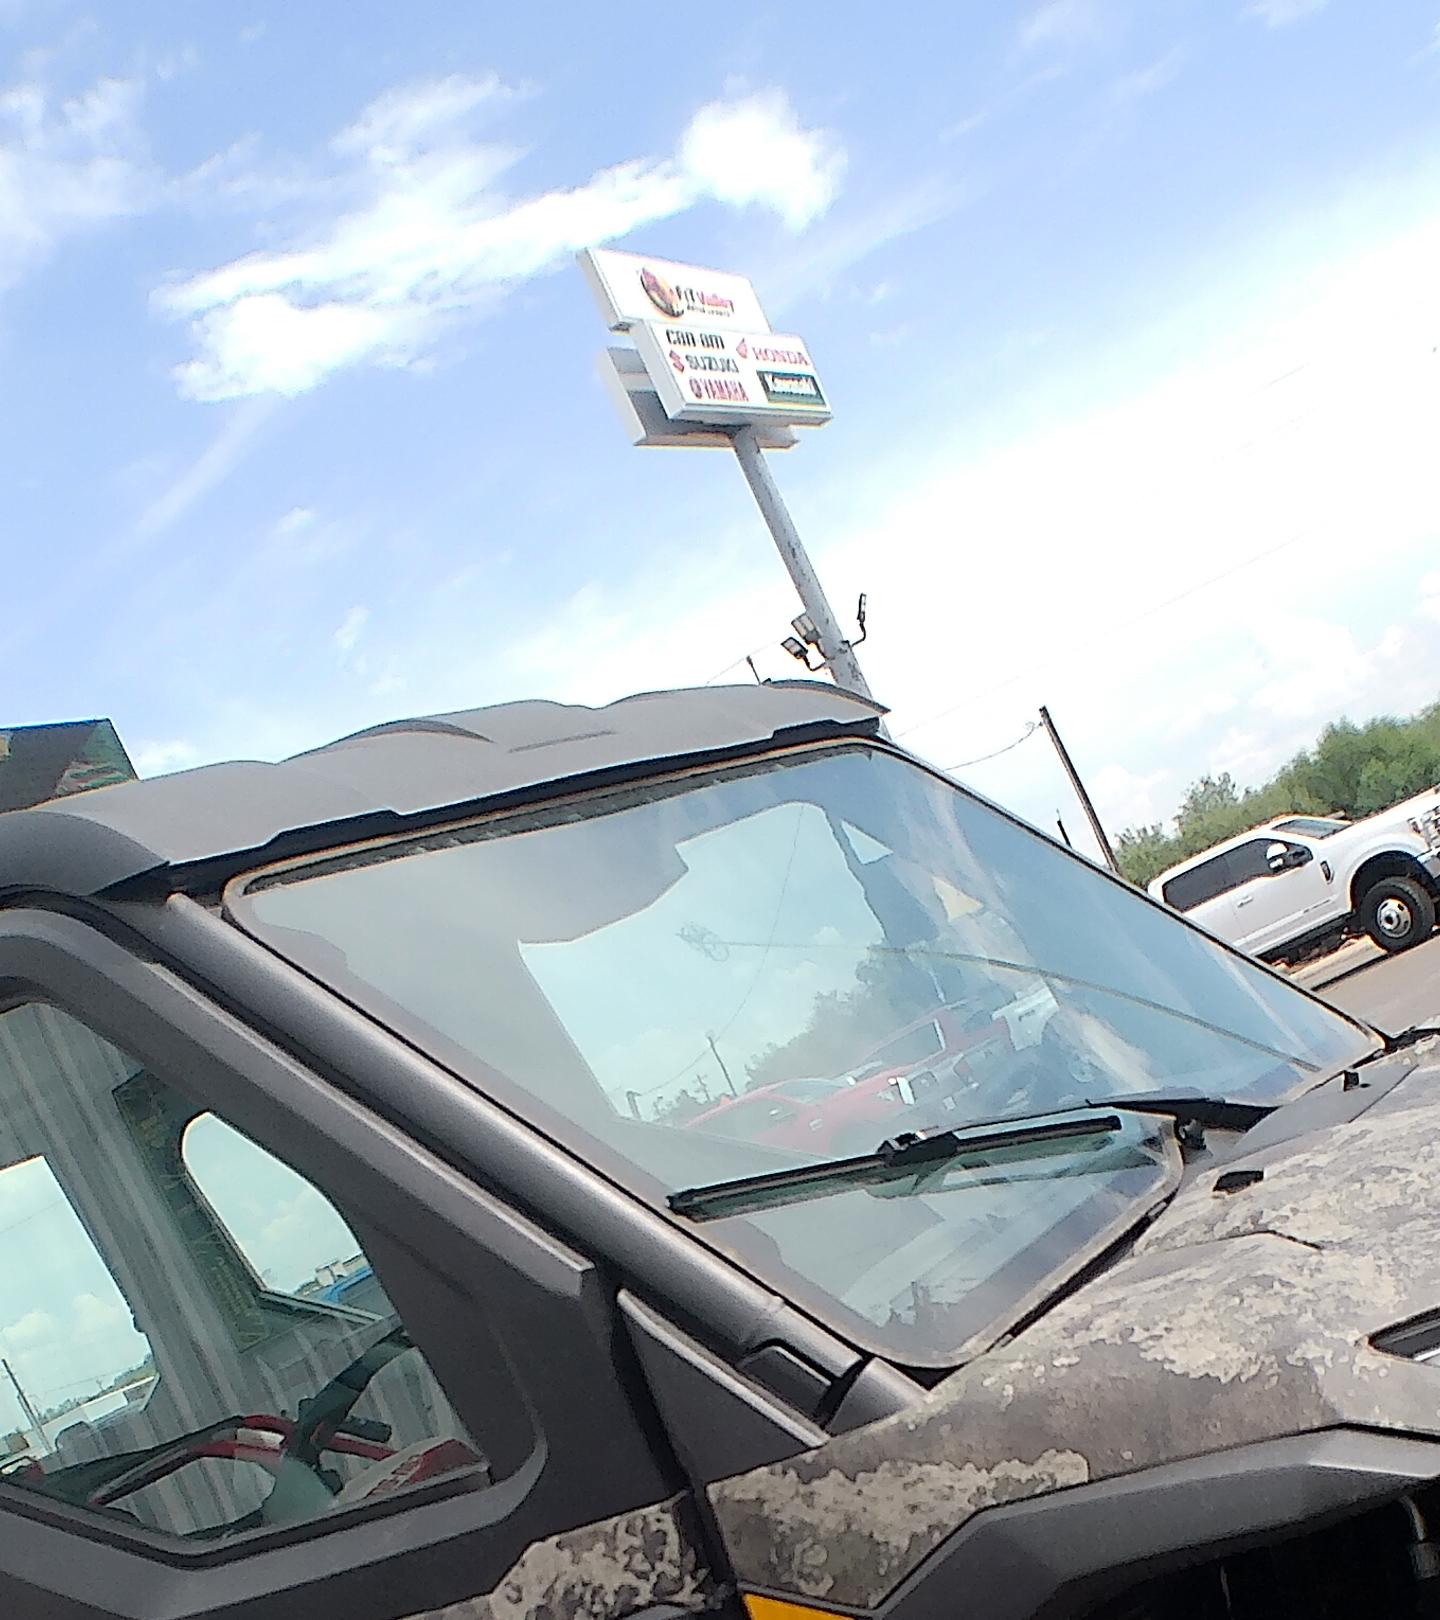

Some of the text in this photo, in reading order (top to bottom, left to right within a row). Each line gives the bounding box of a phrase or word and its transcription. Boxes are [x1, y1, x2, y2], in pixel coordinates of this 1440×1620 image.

[684, 353, 740, 374] SUZUKI
[751, 346, 811, 366] HONDA
[700, 377, 750, 403] YAMAHA
